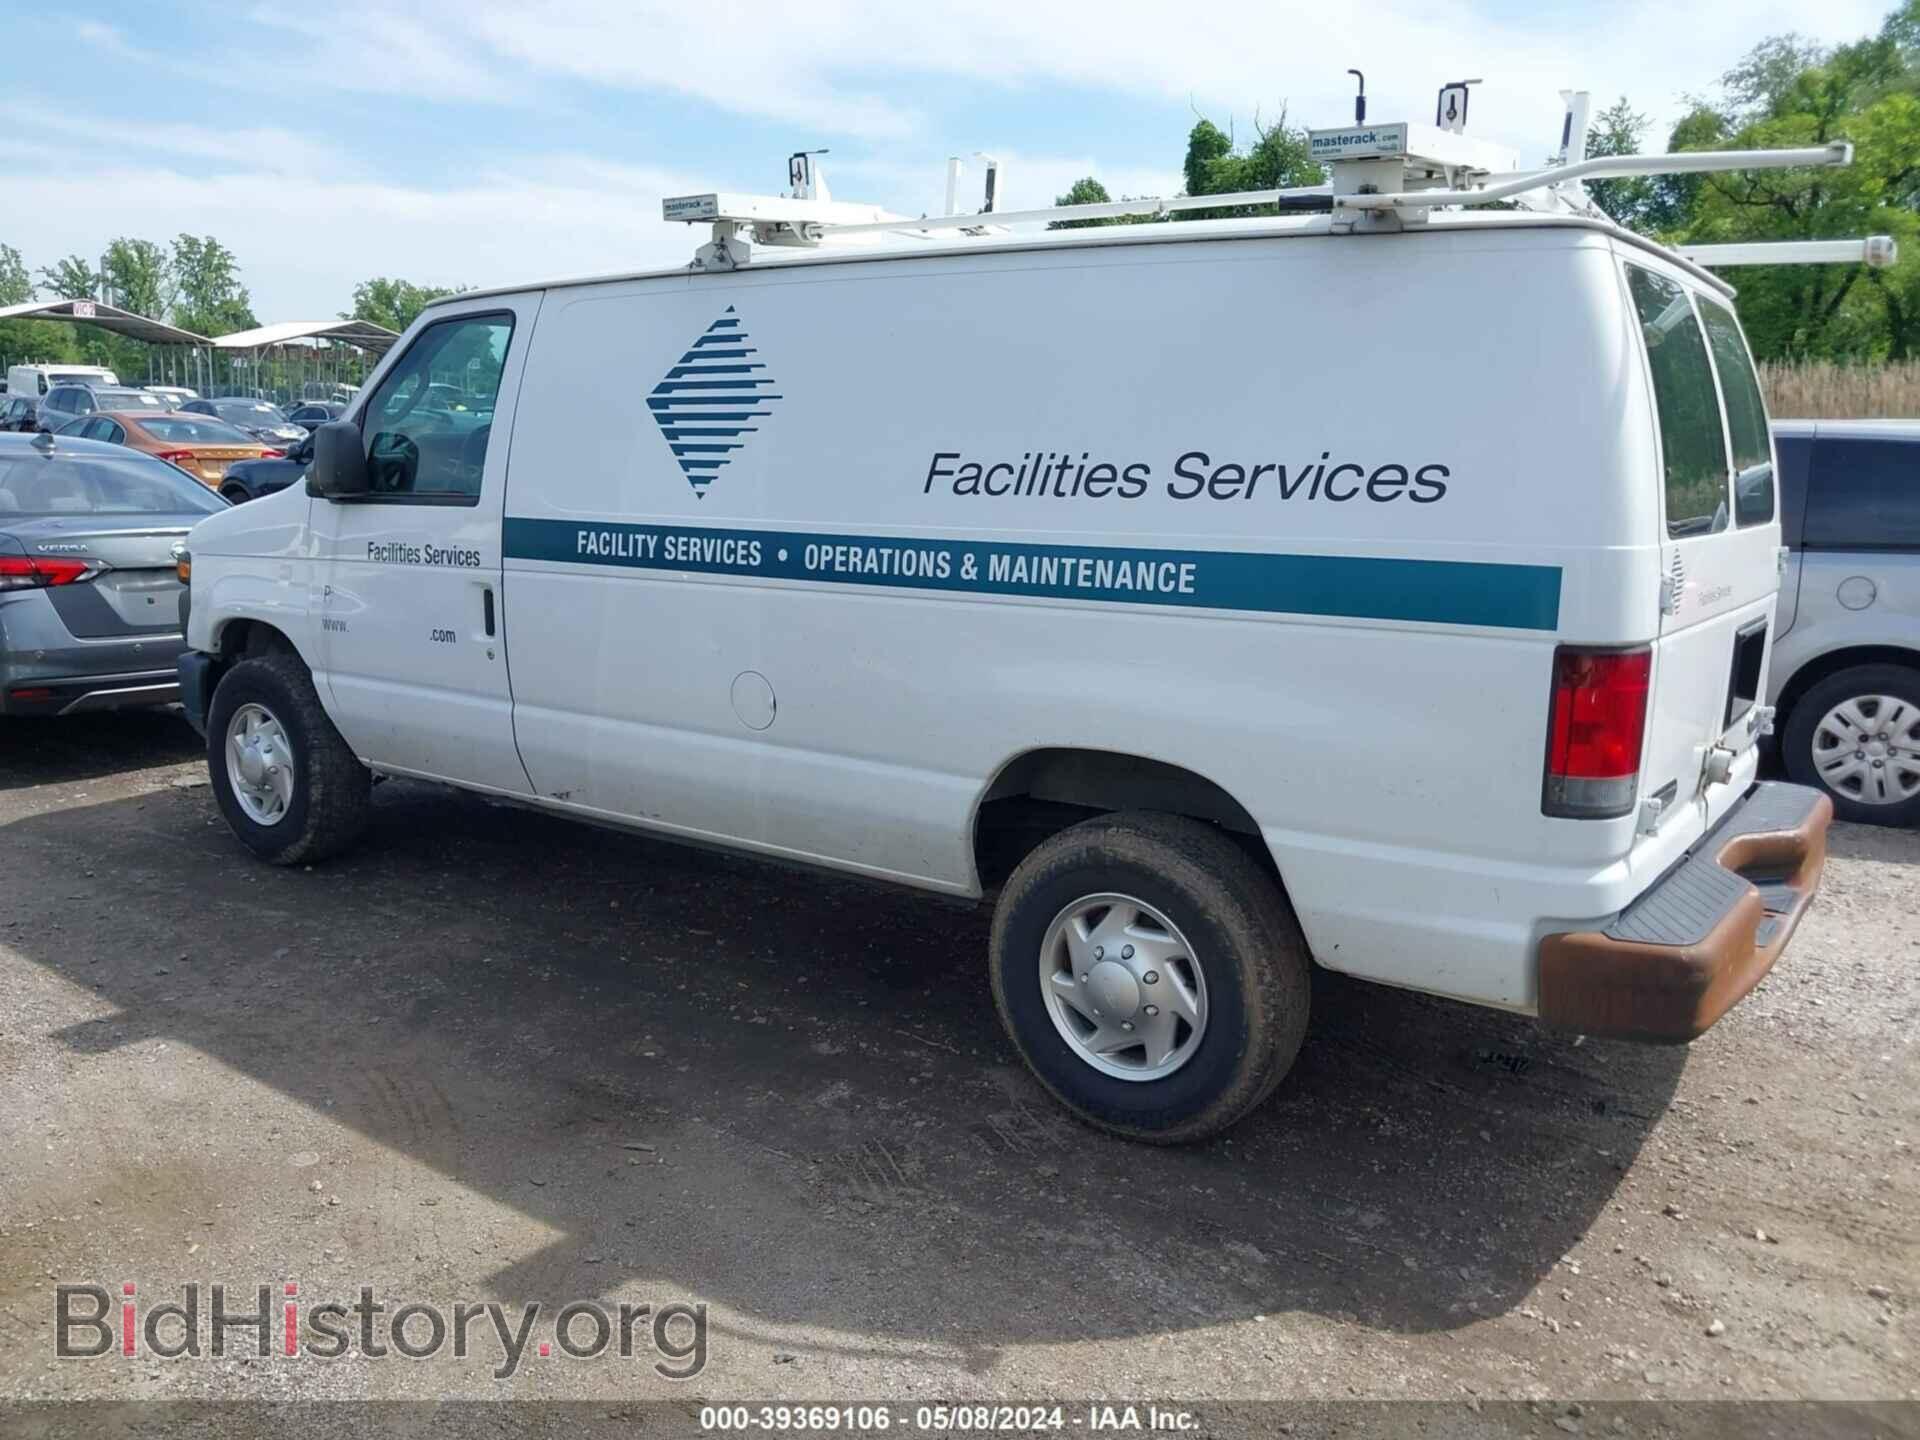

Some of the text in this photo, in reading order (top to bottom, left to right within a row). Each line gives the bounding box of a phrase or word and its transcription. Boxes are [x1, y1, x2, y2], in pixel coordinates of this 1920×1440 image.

[1312, 132, 1376, 148] masterack
[923, 450, 1450, 504] Facilities Services
[367, 541, 481, 567] Facilities Services
[577, 530, 1197, 594] FACILITY SERVICES OPERATIONS & MAINTENANCE
[429, 628, 456, 643] .com
